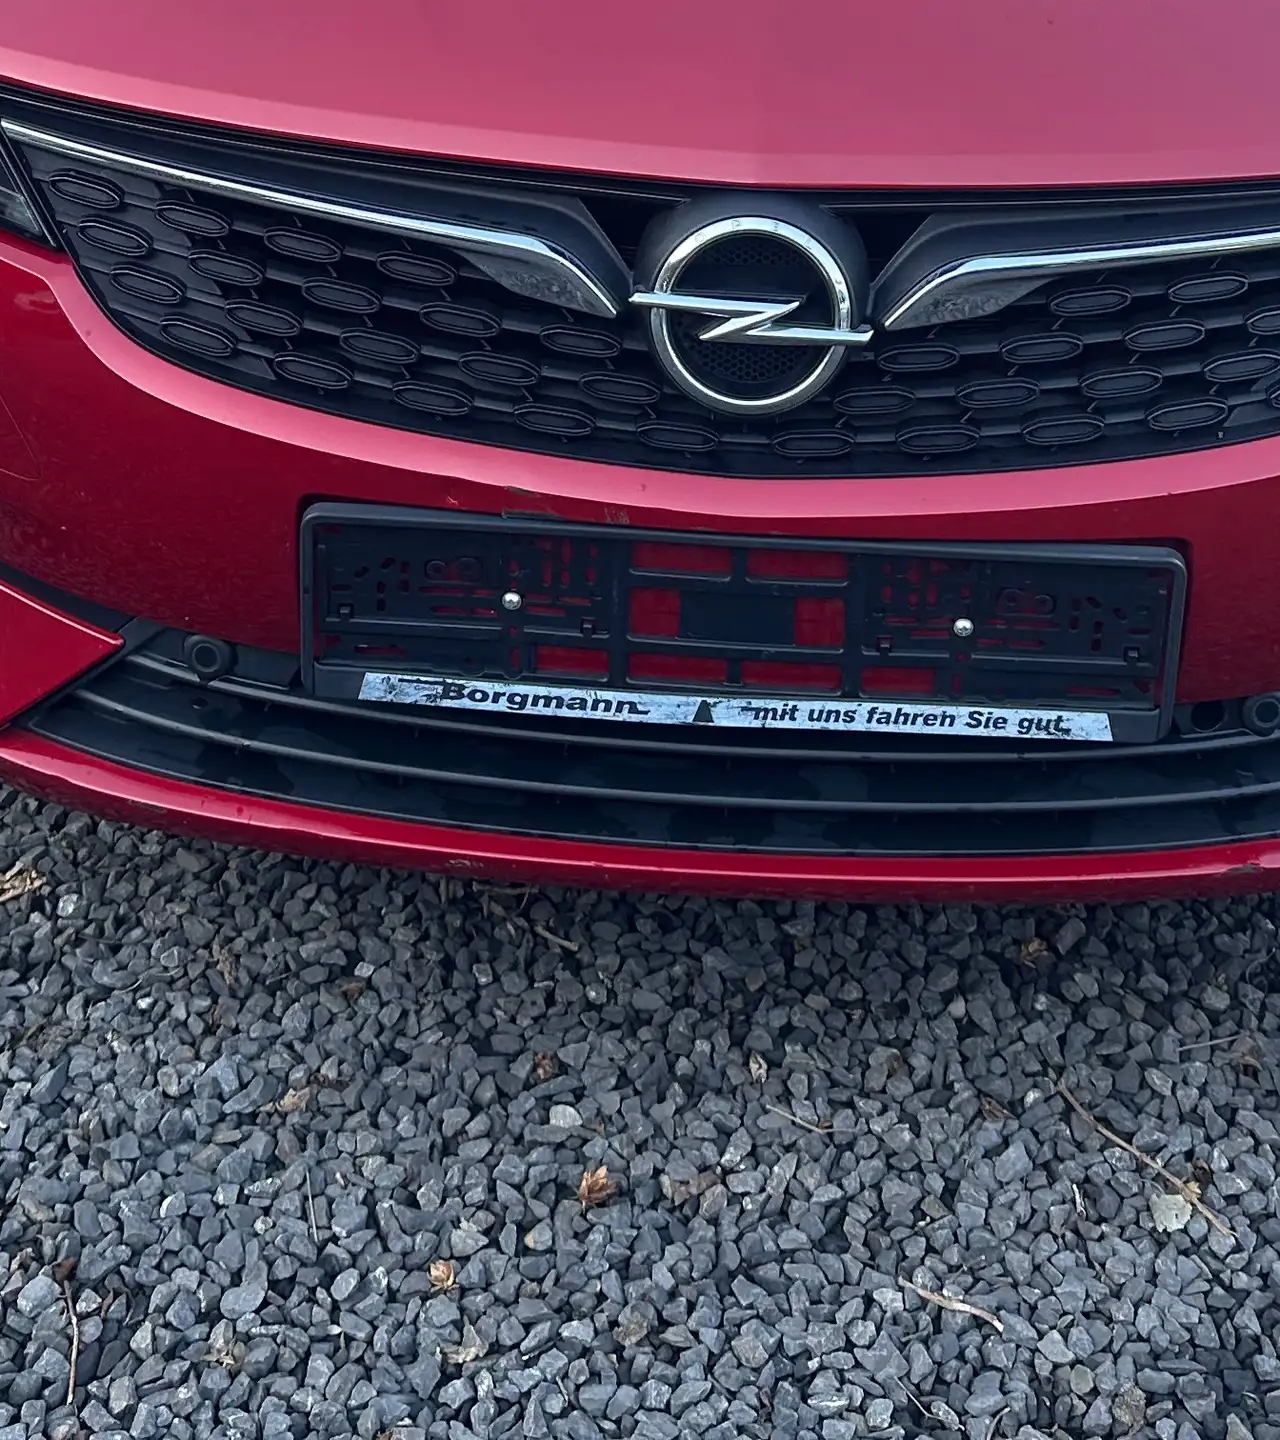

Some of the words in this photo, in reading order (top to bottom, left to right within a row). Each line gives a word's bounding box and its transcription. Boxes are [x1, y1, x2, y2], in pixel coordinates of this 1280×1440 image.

[440, 679, 650, 716] Borgmann
[751, 702, 799, 723] mit
[807, 707, 857, 724] uns
[866, 705, 956, 728] fahren
[965, 710, 1008, 730] Sie
[1017, 716, 1071, 736] gut
